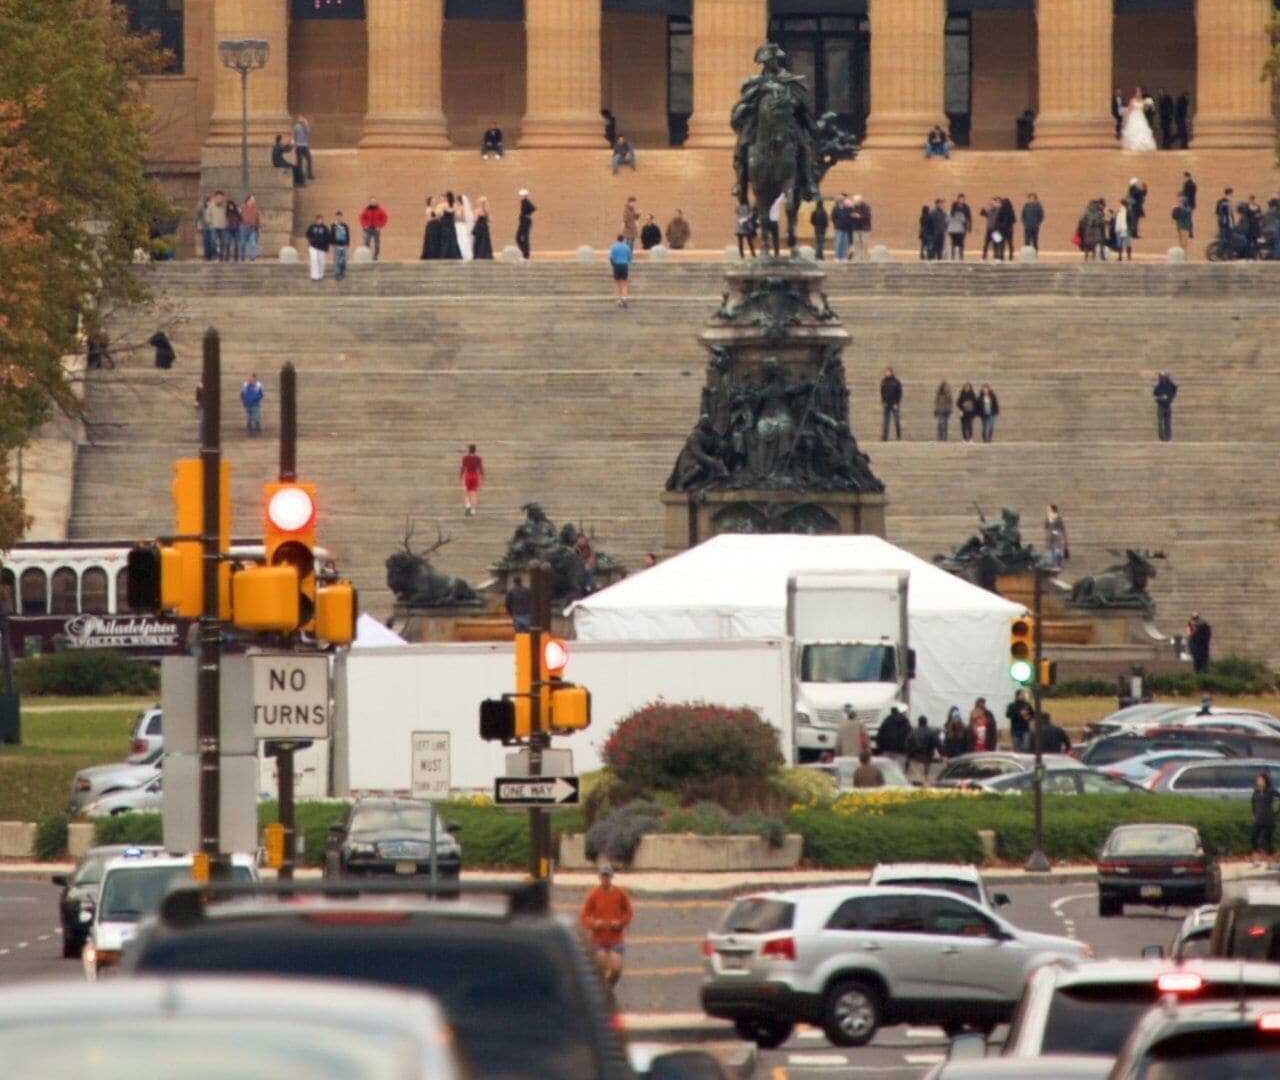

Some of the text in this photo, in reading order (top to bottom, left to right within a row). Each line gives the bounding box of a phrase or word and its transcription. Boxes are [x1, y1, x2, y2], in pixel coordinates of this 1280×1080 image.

[269, 667, 306, 692] NO
[254, 705, 325, 725] TURNS
[420, 759, 442, 772] MUST
[503, 785, 553, 797] ONE WAY
